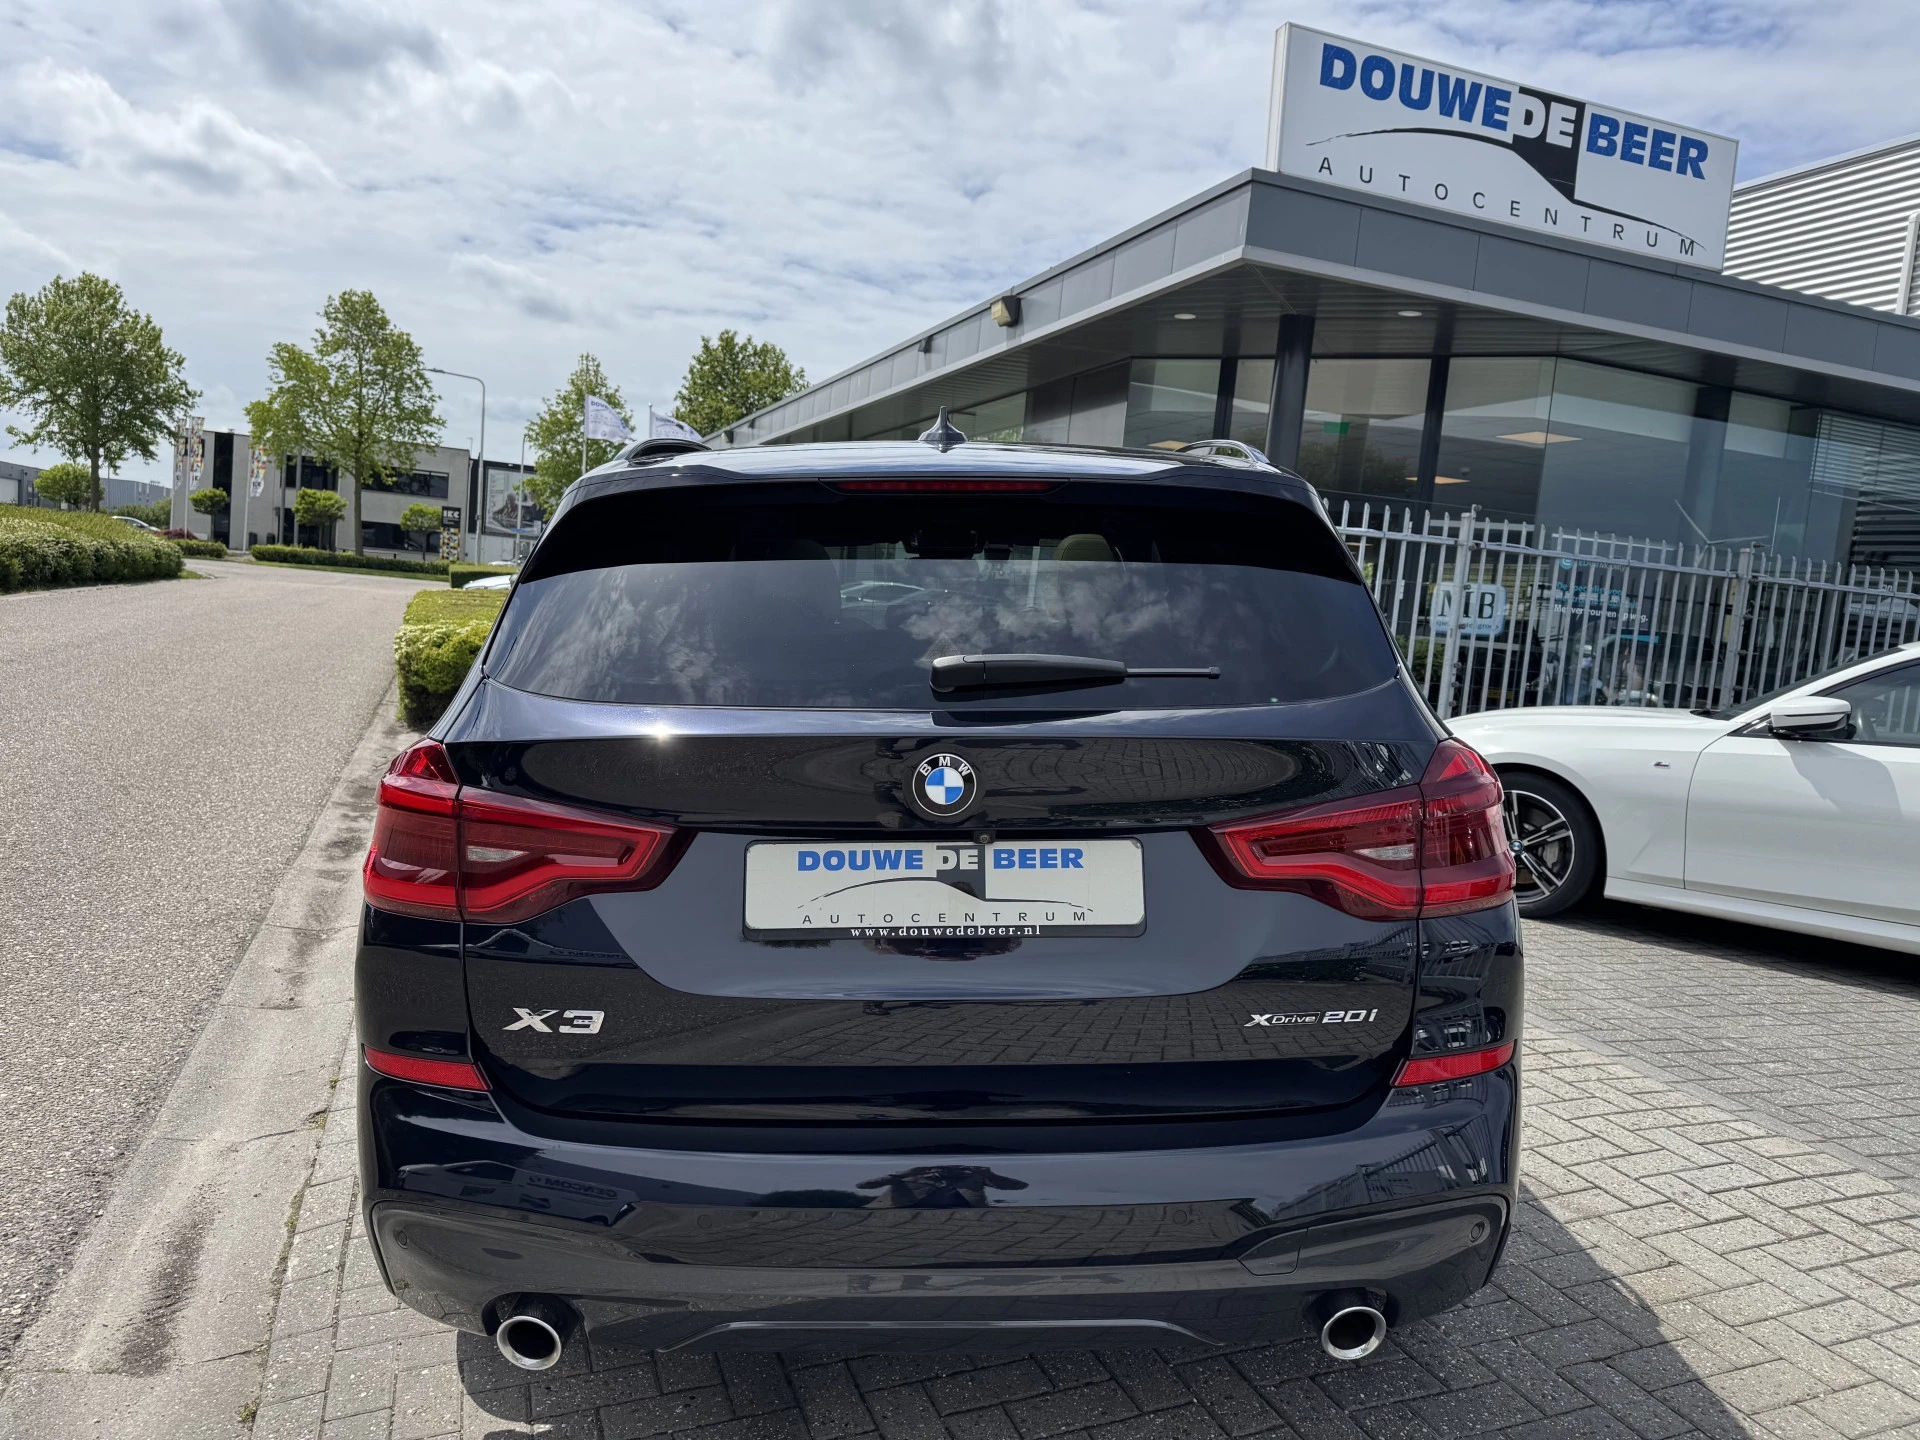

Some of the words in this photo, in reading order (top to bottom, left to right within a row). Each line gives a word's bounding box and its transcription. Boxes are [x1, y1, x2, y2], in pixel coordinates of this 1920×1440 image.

[1319, 42, 1512, 132] DOUWE
[1513, 92, 1577, 149] DE
[1586, 112, 1709, 181] BEER
[1318, 156, 1695, 257] AUTOCENTRUM
[443, 510, 460, 519] IKC
[919, 756, 971, 777] BMW
[797, 849, 923, 871] DOUWE
[936, 849, 979, 870] DE
[993, 848, 1084, 870] BEER
[802, 911, 1086, 925] AUTOCENTRUM
[851, 924, 1042, 937] www.douwedebeer.nl
[502, 1007, 605, 1035] X3
[1322, 1008, 1379, 1024] 20i
